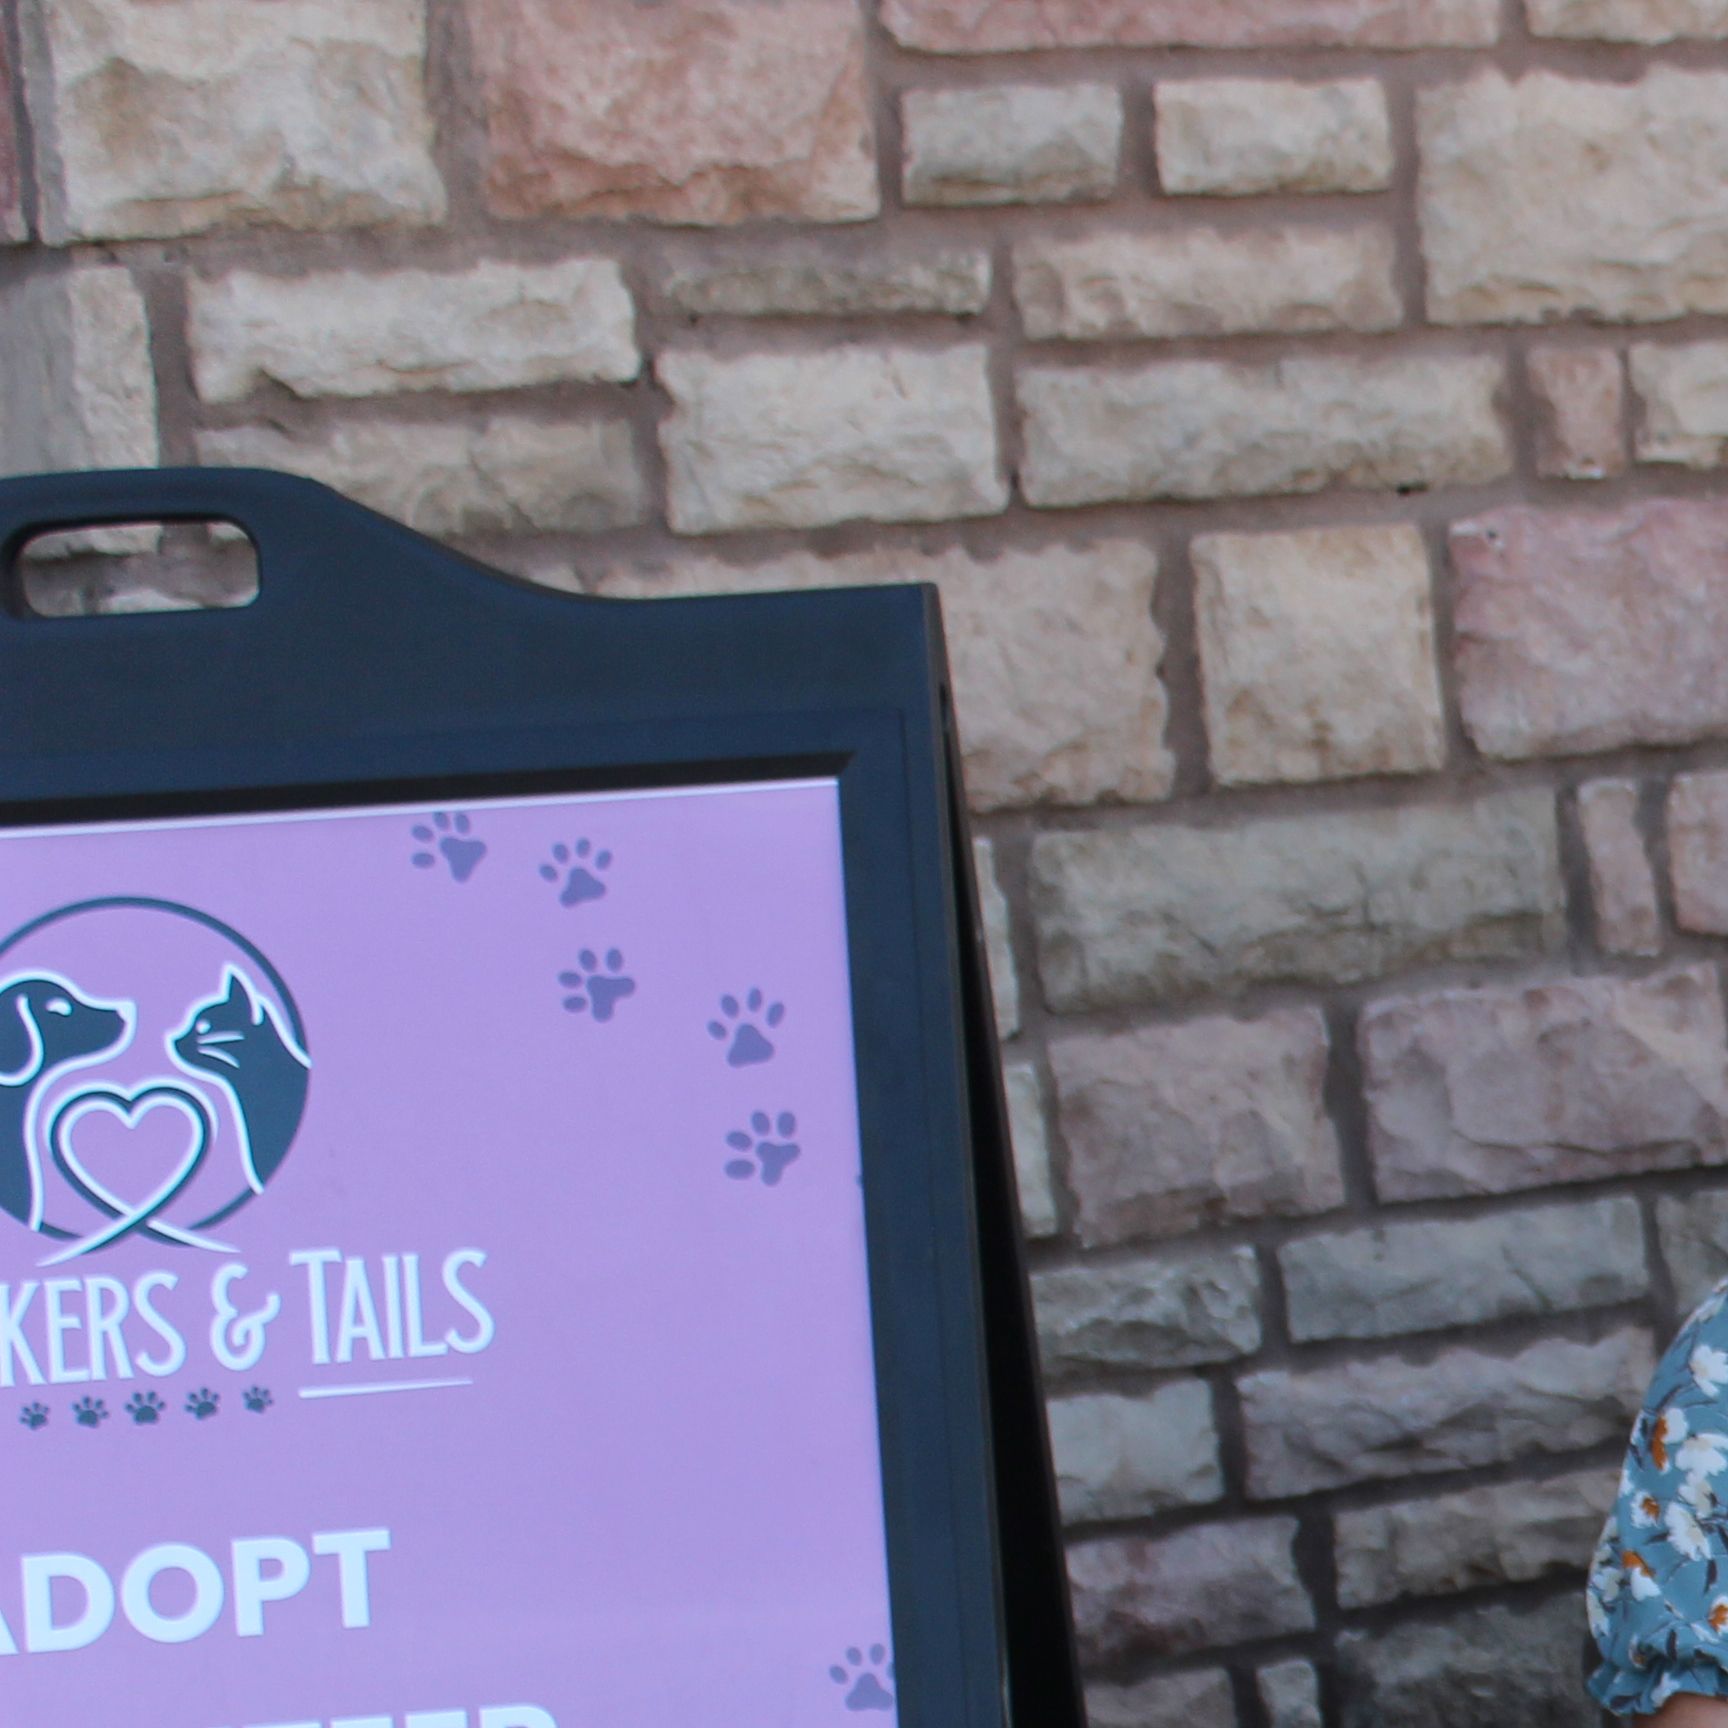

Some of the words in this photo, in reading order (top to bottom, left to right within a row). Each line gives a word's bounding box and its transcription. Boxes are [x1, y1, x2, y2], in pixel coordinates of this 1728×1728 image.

[209, 1263, 281, 1371] &
[289, 1247, 495, 1364] TAILS
[0, 1528, 391, 1656] DOPT
